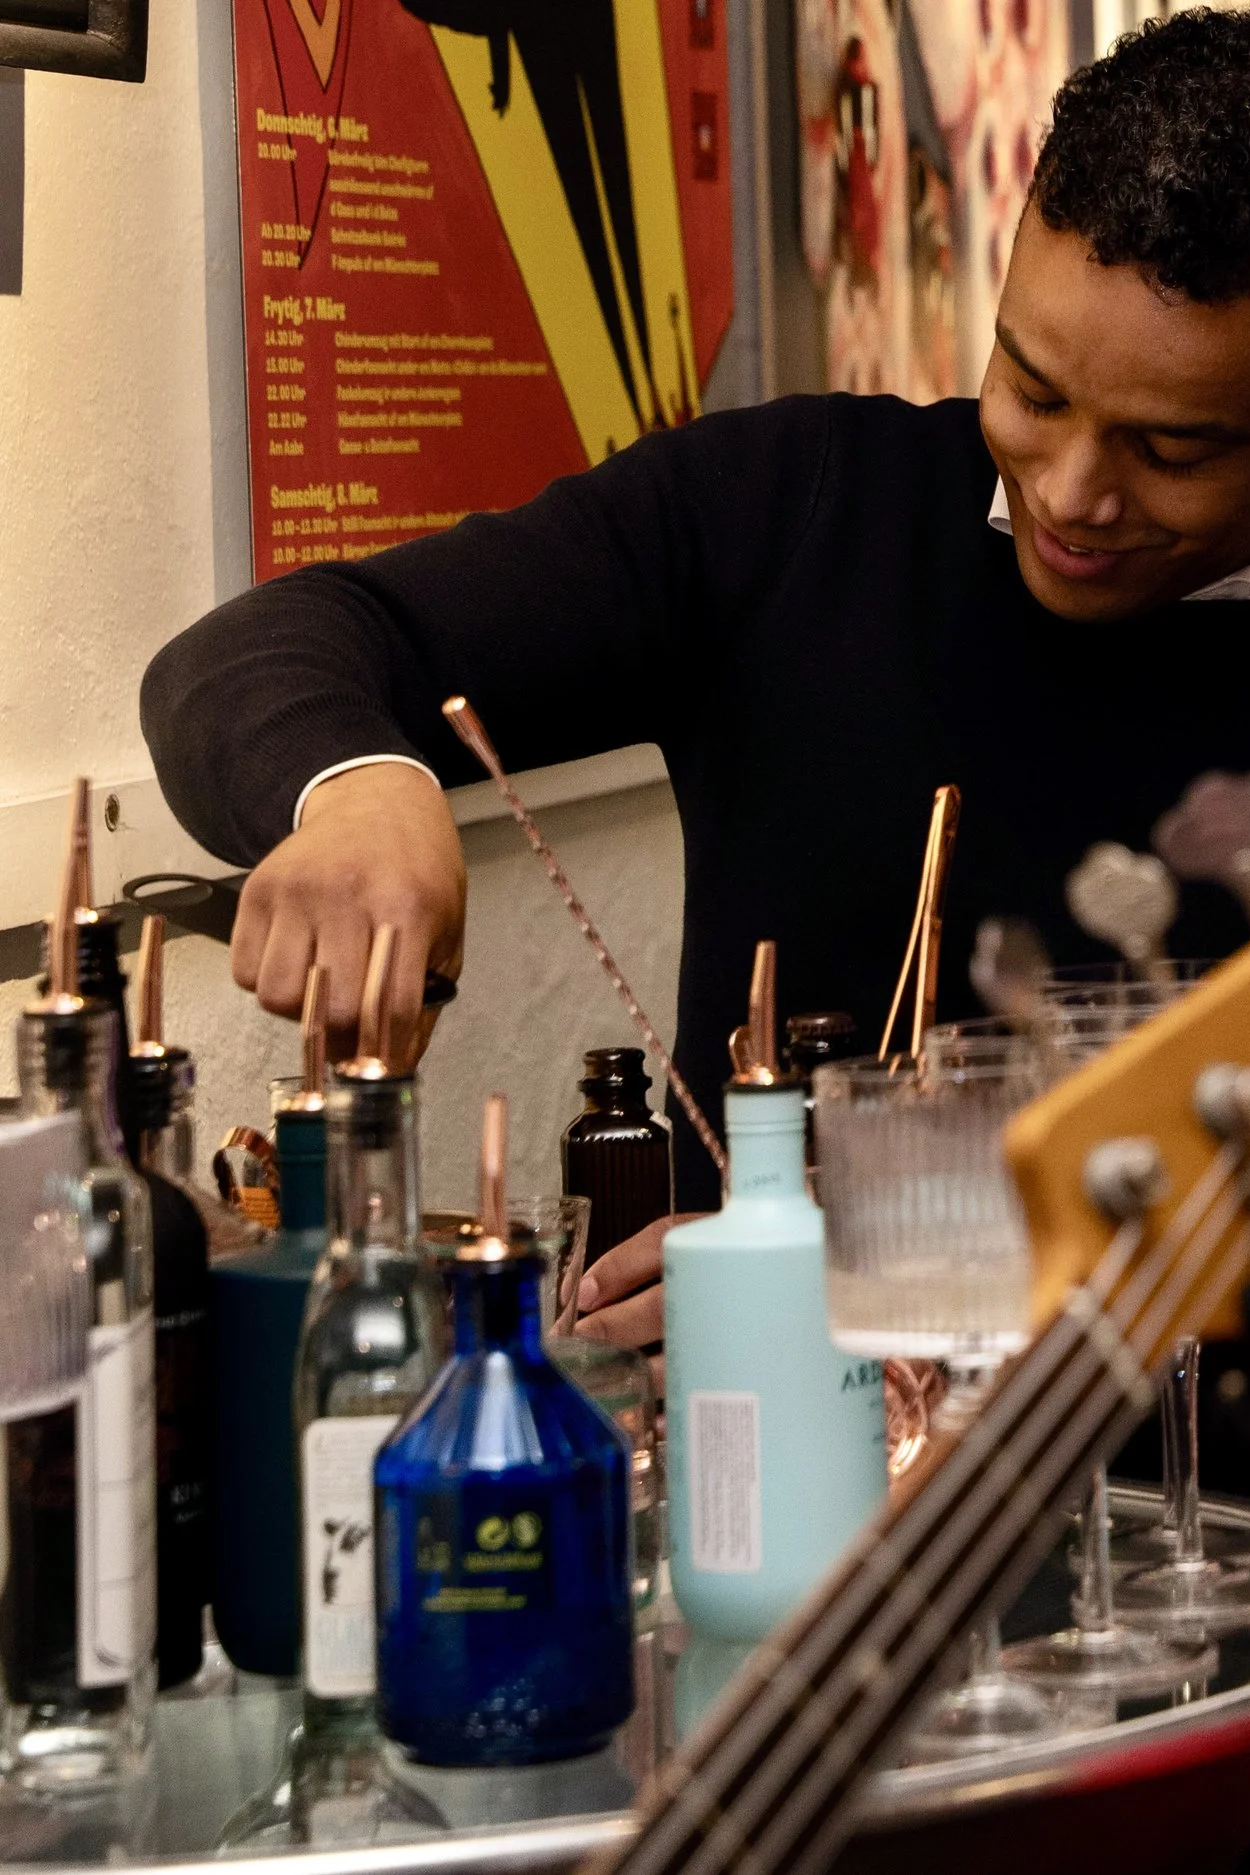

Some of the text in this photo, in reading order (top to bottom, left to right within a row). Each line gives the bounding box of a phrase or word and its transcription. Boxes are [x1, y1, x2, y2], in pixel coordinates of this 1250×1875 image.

[257, 108, 326, 144] Donnschtig,
[340, 116, 369, 142] März
[282, 144, 297, 161] Uhr
[263, 295, 346, 326] Frytig, 7. März
[288, 330, 304, 346] Uhr
[289, 357, 305, 374] Uhr
[291, 384, 306, 401] Uhr
[292, 411, 307, 429] Uhr
[271, 484, 336, 513] Samschtig,
[349, 481, 379, 505] März
